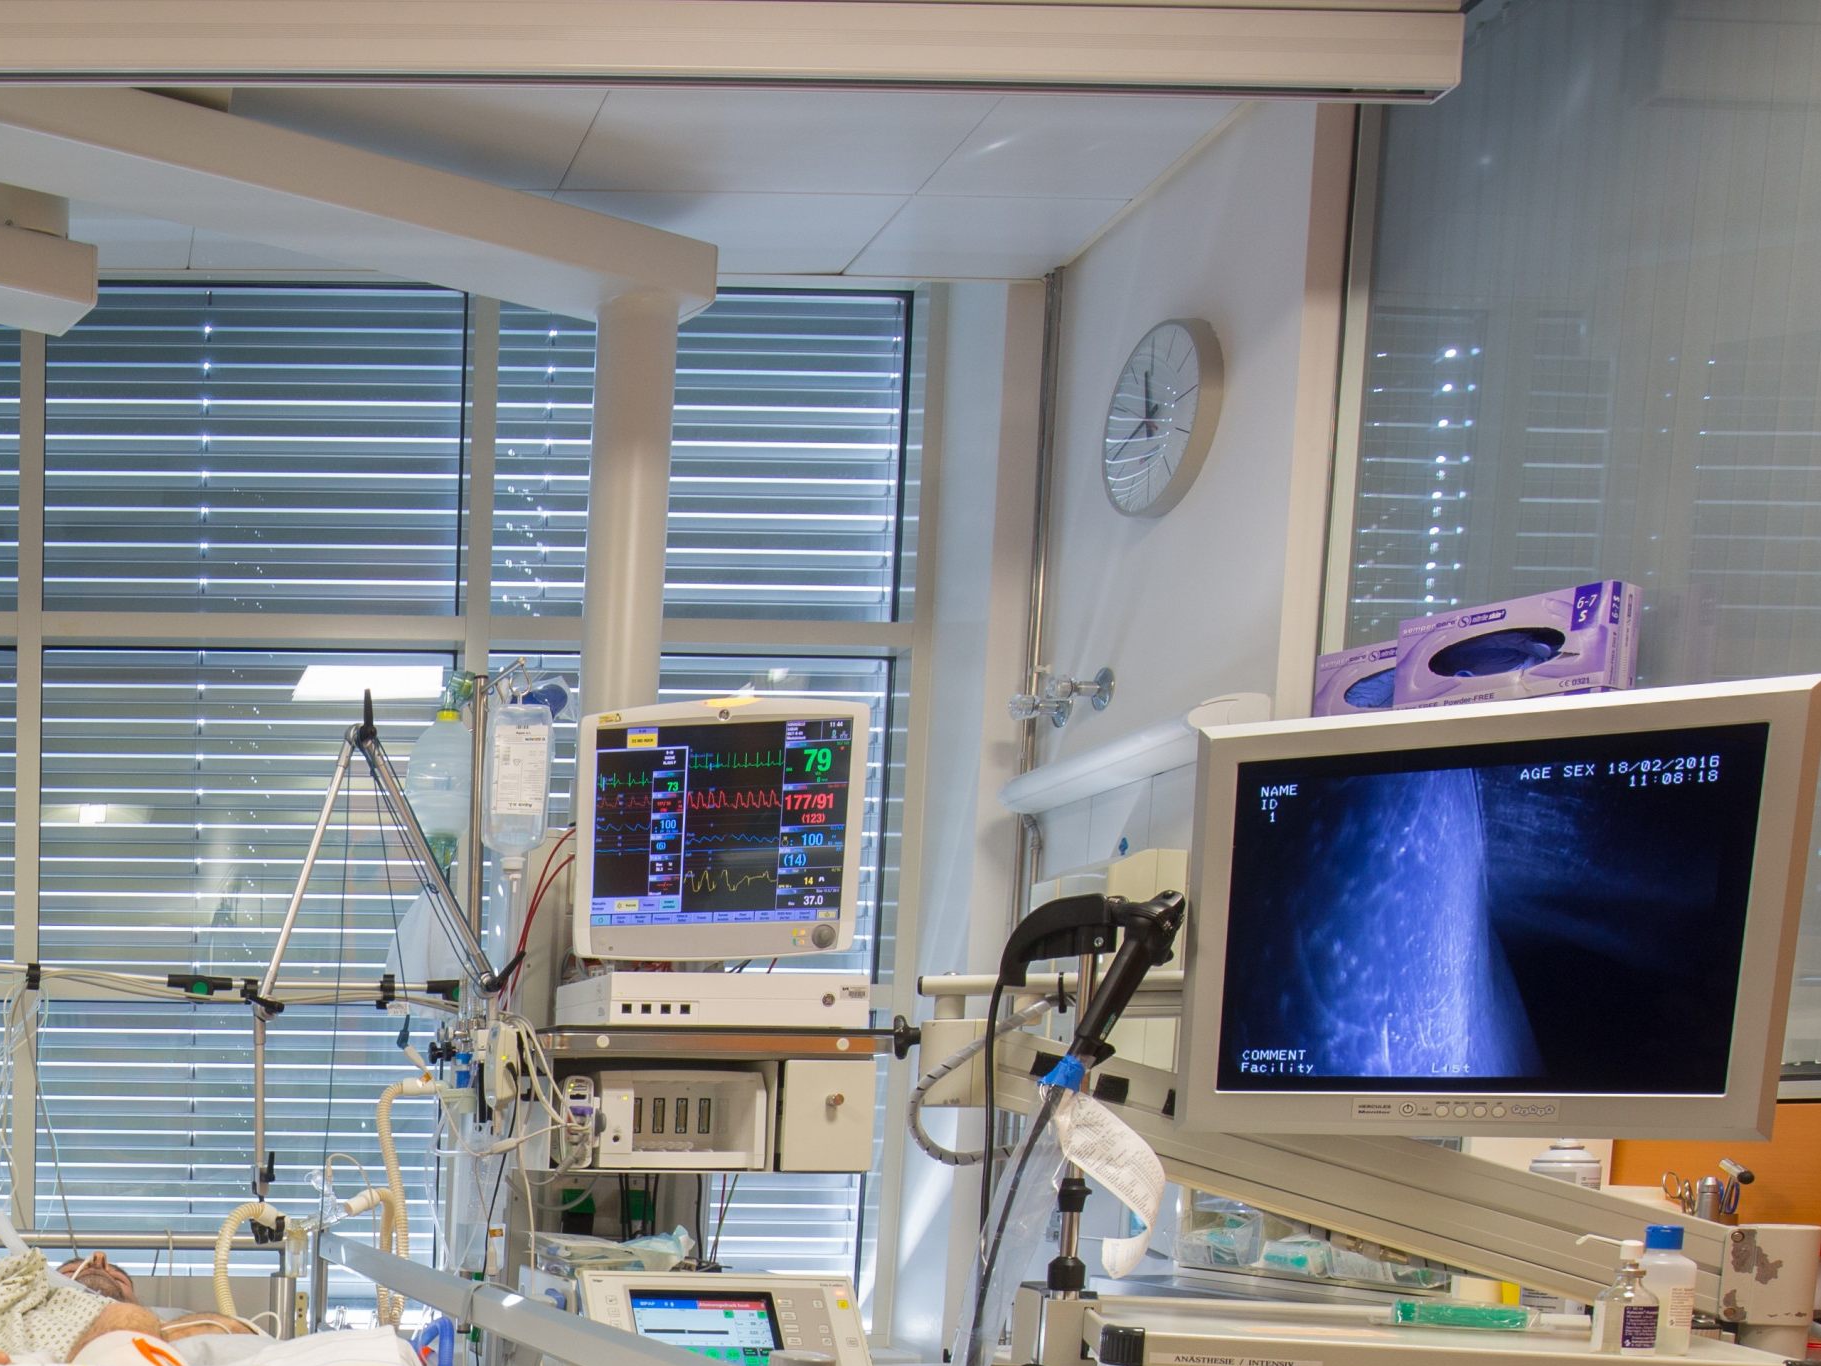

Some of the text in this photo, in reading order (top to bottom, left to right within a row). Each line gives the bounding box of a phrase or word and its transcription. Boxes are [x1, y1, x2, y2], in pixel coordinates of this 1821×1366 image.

[1576, 594, 1598, 609] 6-7
[1578, 610, 1588, 622] S
[803, 748, 832, 772] 79
[1519, 755, 1721, 781] AGE SEX 18/02/2016
[1628, 769, 1719, 787] 11:08:18
[667, 781, 679, 792] 73
[1260, 784, 1298, 797] NAME
[784, 793, 835, 810] 177/91
[1261, 798, 1278, 810] ID
[801, 813, 825, 823] (123)
[1269, 811, 1276, 822] 1
[801, 833, 824, 846] 100
[783, 854, 807, 867] (14)
[803, 877, 814, 885] 14
[803, 895, 824, 906] 37.0
[1241, 1049, 1307, 1061] COMMENT
[1240, 1061, 1315, 1075] Facility
